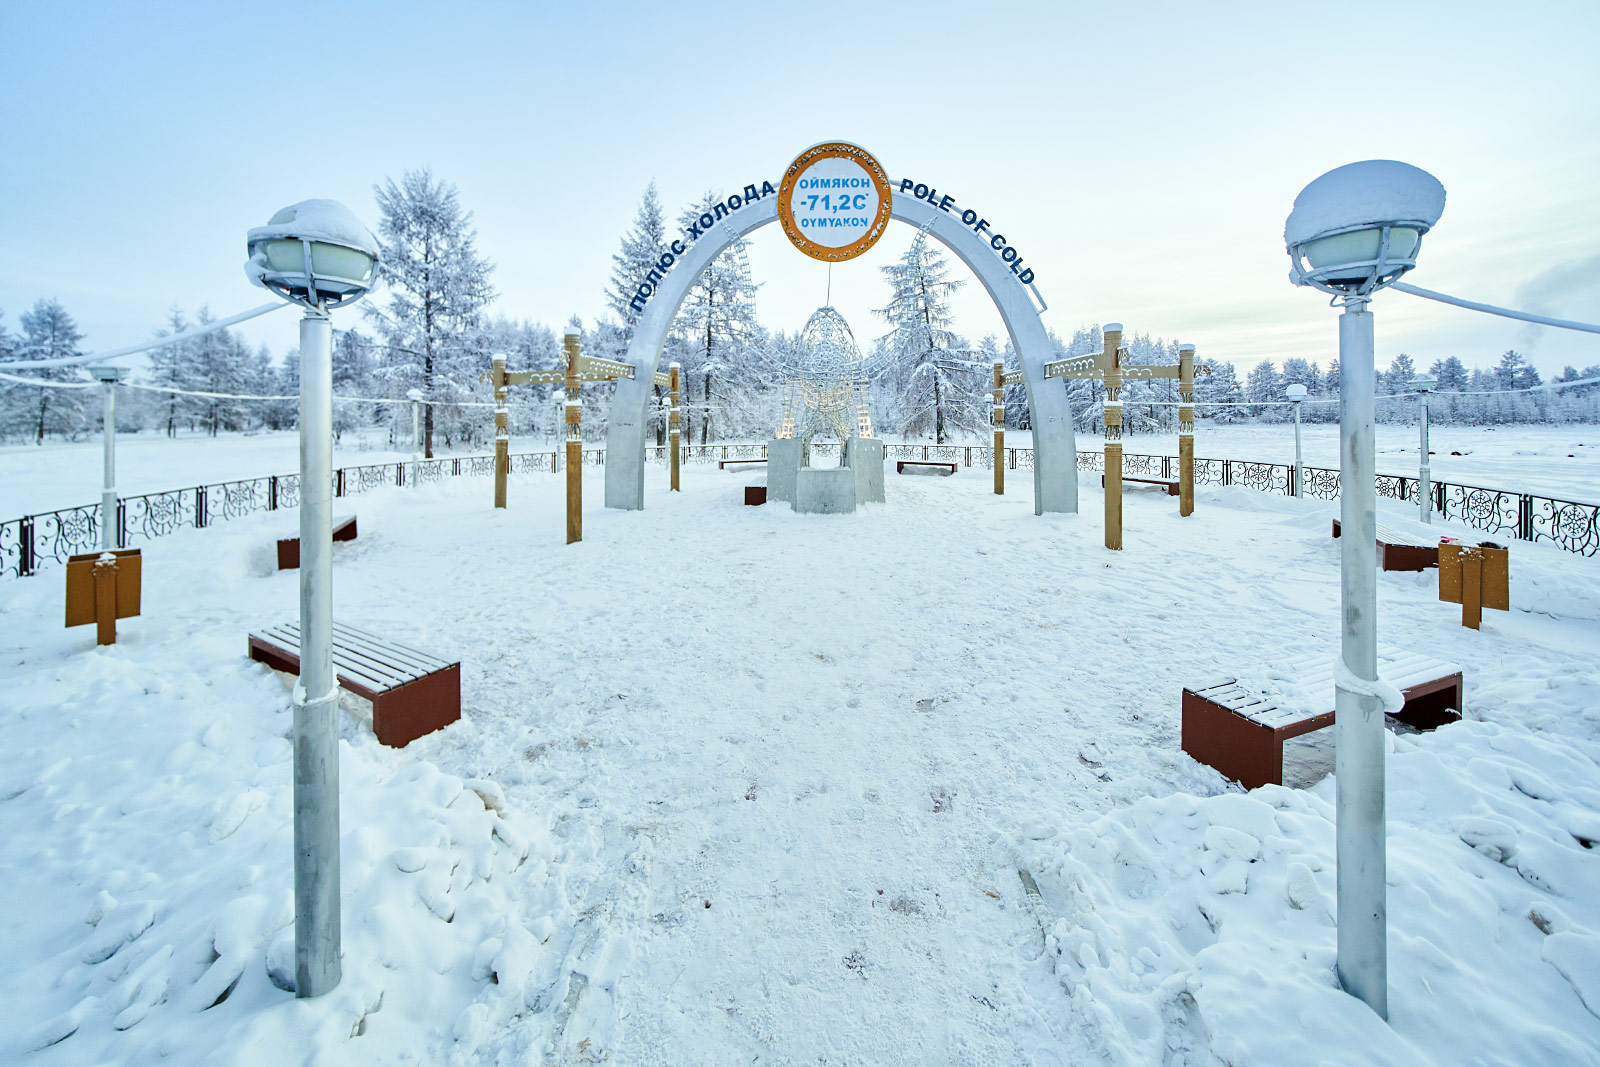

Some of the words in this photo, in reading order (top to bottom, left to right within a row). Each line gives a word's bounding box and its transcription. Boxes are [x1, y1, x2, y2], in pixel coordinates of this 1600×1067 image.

[799, 177, 870, 189] ОЙМЯКОН
[629, 239, 686, 312] ПОЛЮС
[686, 180, 776, 240] ХОЛОДА
[801, 217, 868, 227] OYMYAKON
[900, 178, 955, 212] POLE
[961, 209, 990, 232] OF
[990, 234, 1035, 284] COLD
